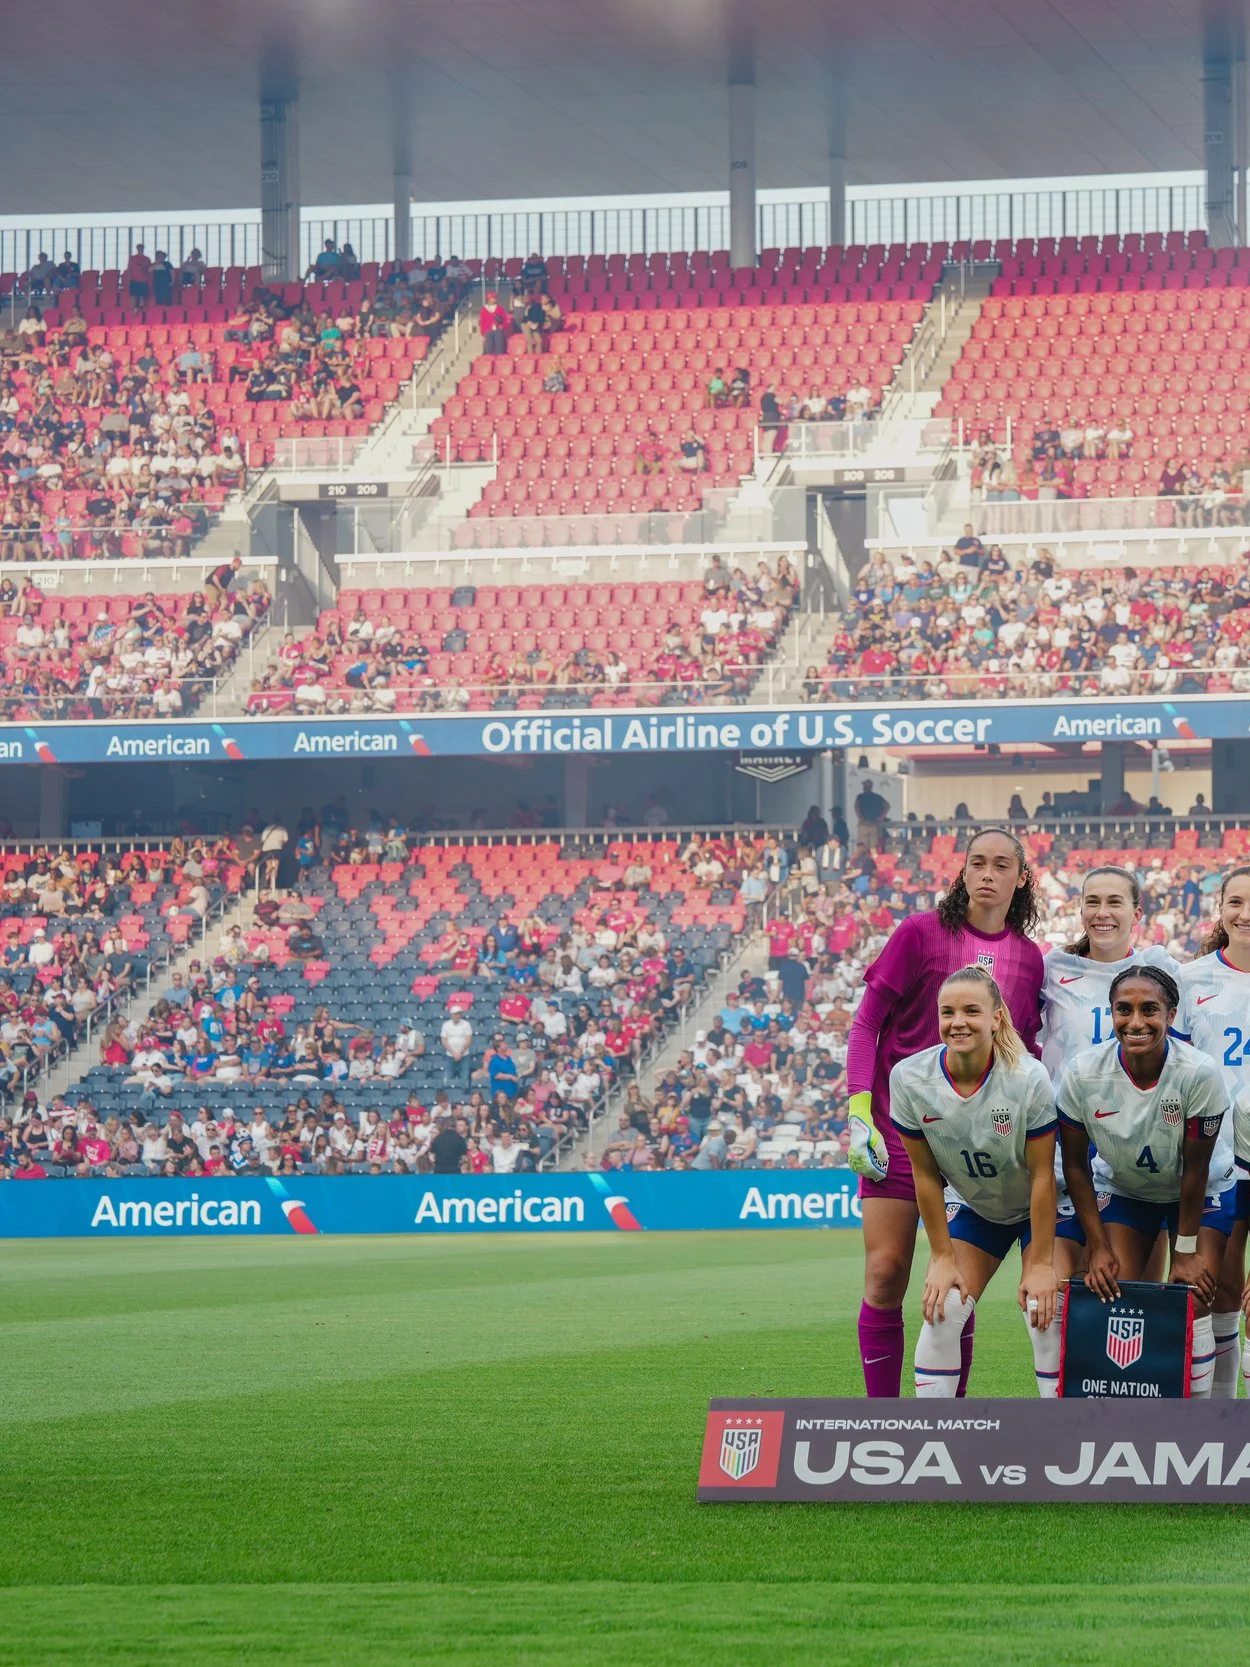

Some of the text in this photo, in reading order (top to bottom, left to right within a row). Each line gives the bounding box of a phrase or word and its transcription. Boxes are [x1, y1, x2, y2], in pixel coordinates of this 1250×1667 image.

[327, 484, 378, 496] 210 209
[481, 713, 992, 753] Official Airline of U.S. Soccer
[1053, 714, 1161, 737] American
[107, 735, 210, 756] American
[294, 731, 398, 753] American
[978, 956, 993, 966] USA
[1162, 1103, 1180, 1113] USA
[993, 1114, 1010, 1124] USA
[960, 1149, 999, 1178] 16
[1136, 1145, 1160, 1174] 4
[92, 1193, 261, 1227] American
[415, 1190, 584, 1224] American
[1110, 1319, 1142, 1340] USA
[1082, 1378, 1162, 1398] ONE NATION.
[796, 1419, 1000, 1431] INTERNATIONAL MATCH
[724, 1431, 758, 1450] USA
[793, 1441, 962, 1485] USA
